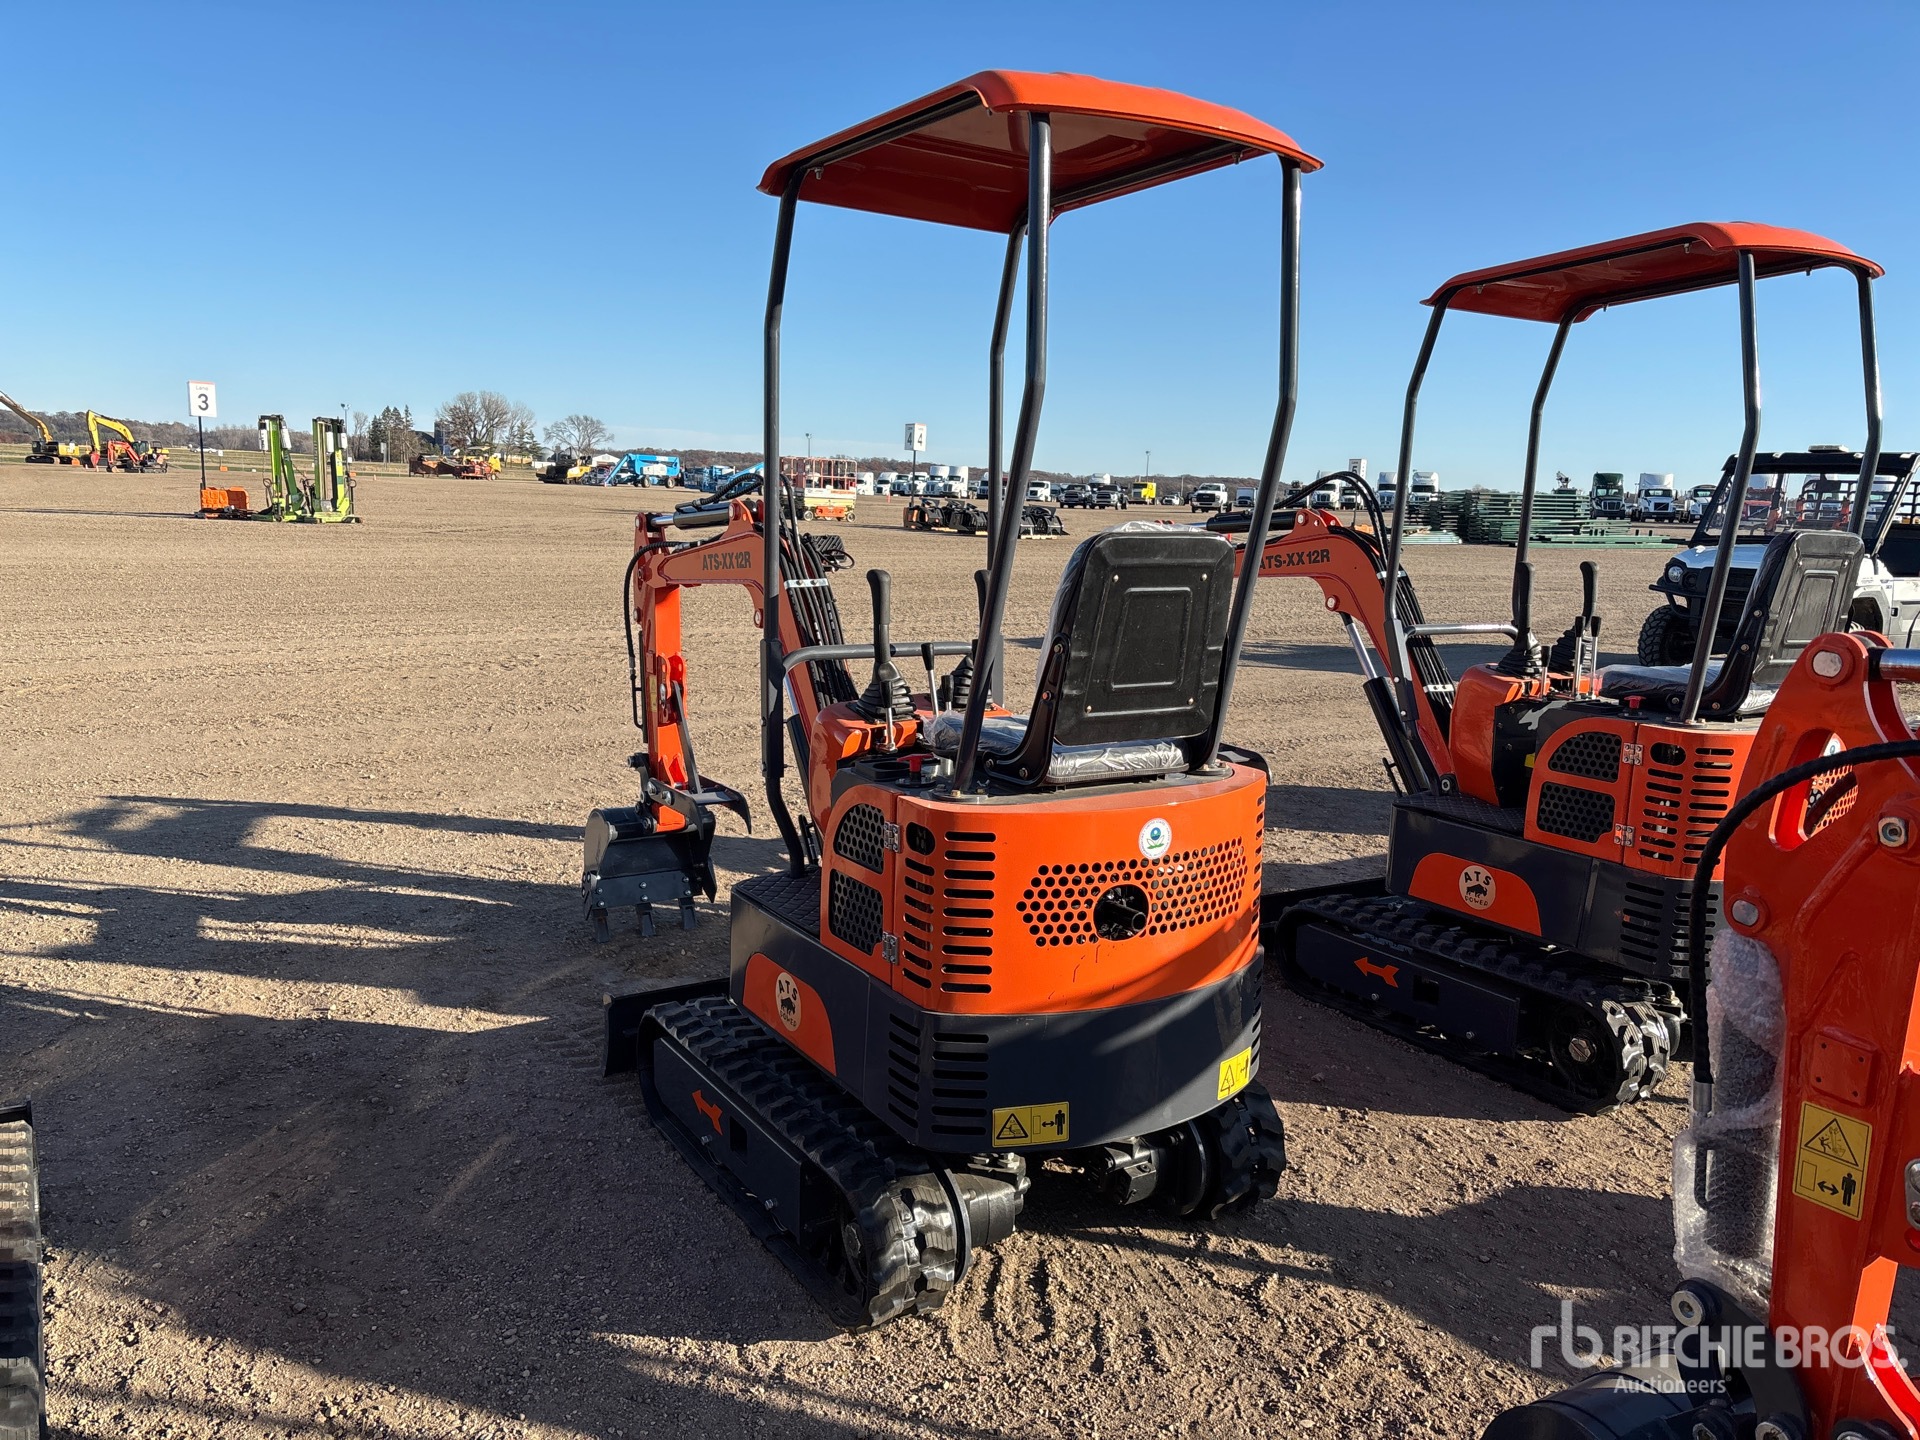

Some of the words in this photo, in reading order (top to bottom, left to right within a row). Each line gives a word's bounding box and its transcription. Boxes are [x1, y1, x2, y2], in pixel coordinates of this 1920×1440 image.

[198, 393, 209, 411] 3
[907, 432, 912, 446] 4
[917, 433, 923, 446] 4
[702, 551, 752, 571] ATS-XX12R
[1464, 871, 1492, 886] ATS
[1464, 895, 1489, 906] POWER
[778, 979, 798, 1001] ATS
